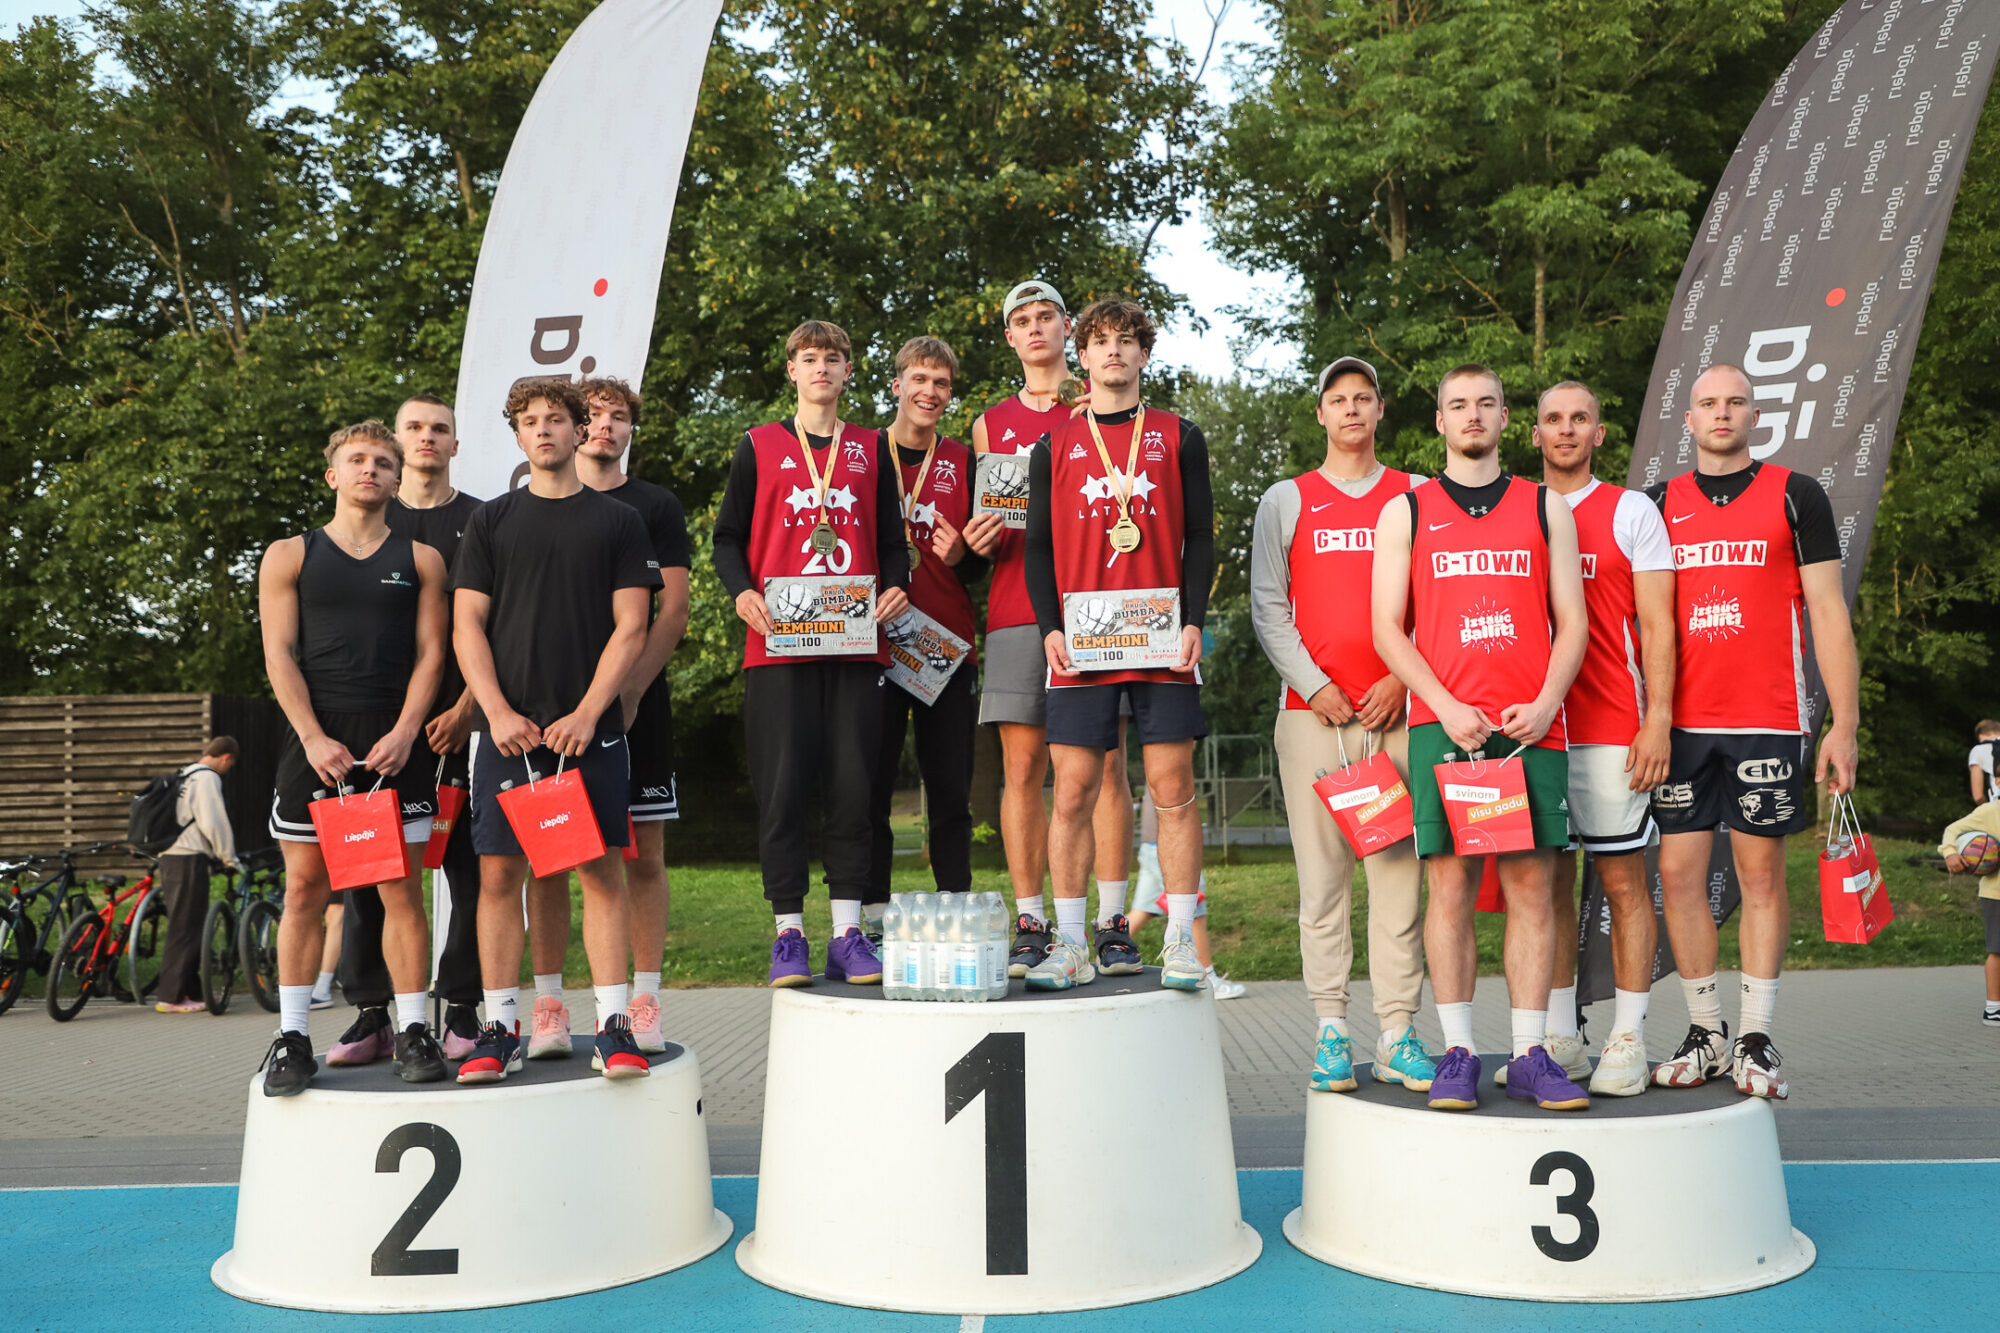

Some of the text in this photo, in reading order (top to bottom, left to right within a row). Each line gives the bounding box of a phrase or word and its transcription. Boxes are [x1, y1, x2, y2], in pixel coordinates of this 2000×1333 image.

[981, 492, 1029, 509] ČEMPI
[784, 515, 860, 527] LATIJA
[1007, 512, 1026, 521] 100
[1316, 530, 1375, 549] G-TO
[801, 538, 852, 575] 20
[1435, 552, 1529, 573] G-TOWN
[1675, 543, 1764, 565] G-TOWN
[813, 594, 853, 606] BUMBA
[1114, 607, 1155, 620] BUMBA
[773, 619, 845, 634] ČEMPIONI
[801, 637, 821, 647] 100
[1073, 633, 1148, 649] ČEMPIONI
[888, 642, 924, 673] PIONI
[1103, 650, 1123, 661] 100
[1360, 784, 1405, 819] visu gadu!
[1456, 789, 1495, 799] svinam
[1470, 796, 1526, 819] visu gadu!
[432, 820, 449, 830] du!
[945, 1032, 1028, 1275] 1
[370, 1122, 461, 1276] 2
[1529, 1151, 1599, 1262] 3
